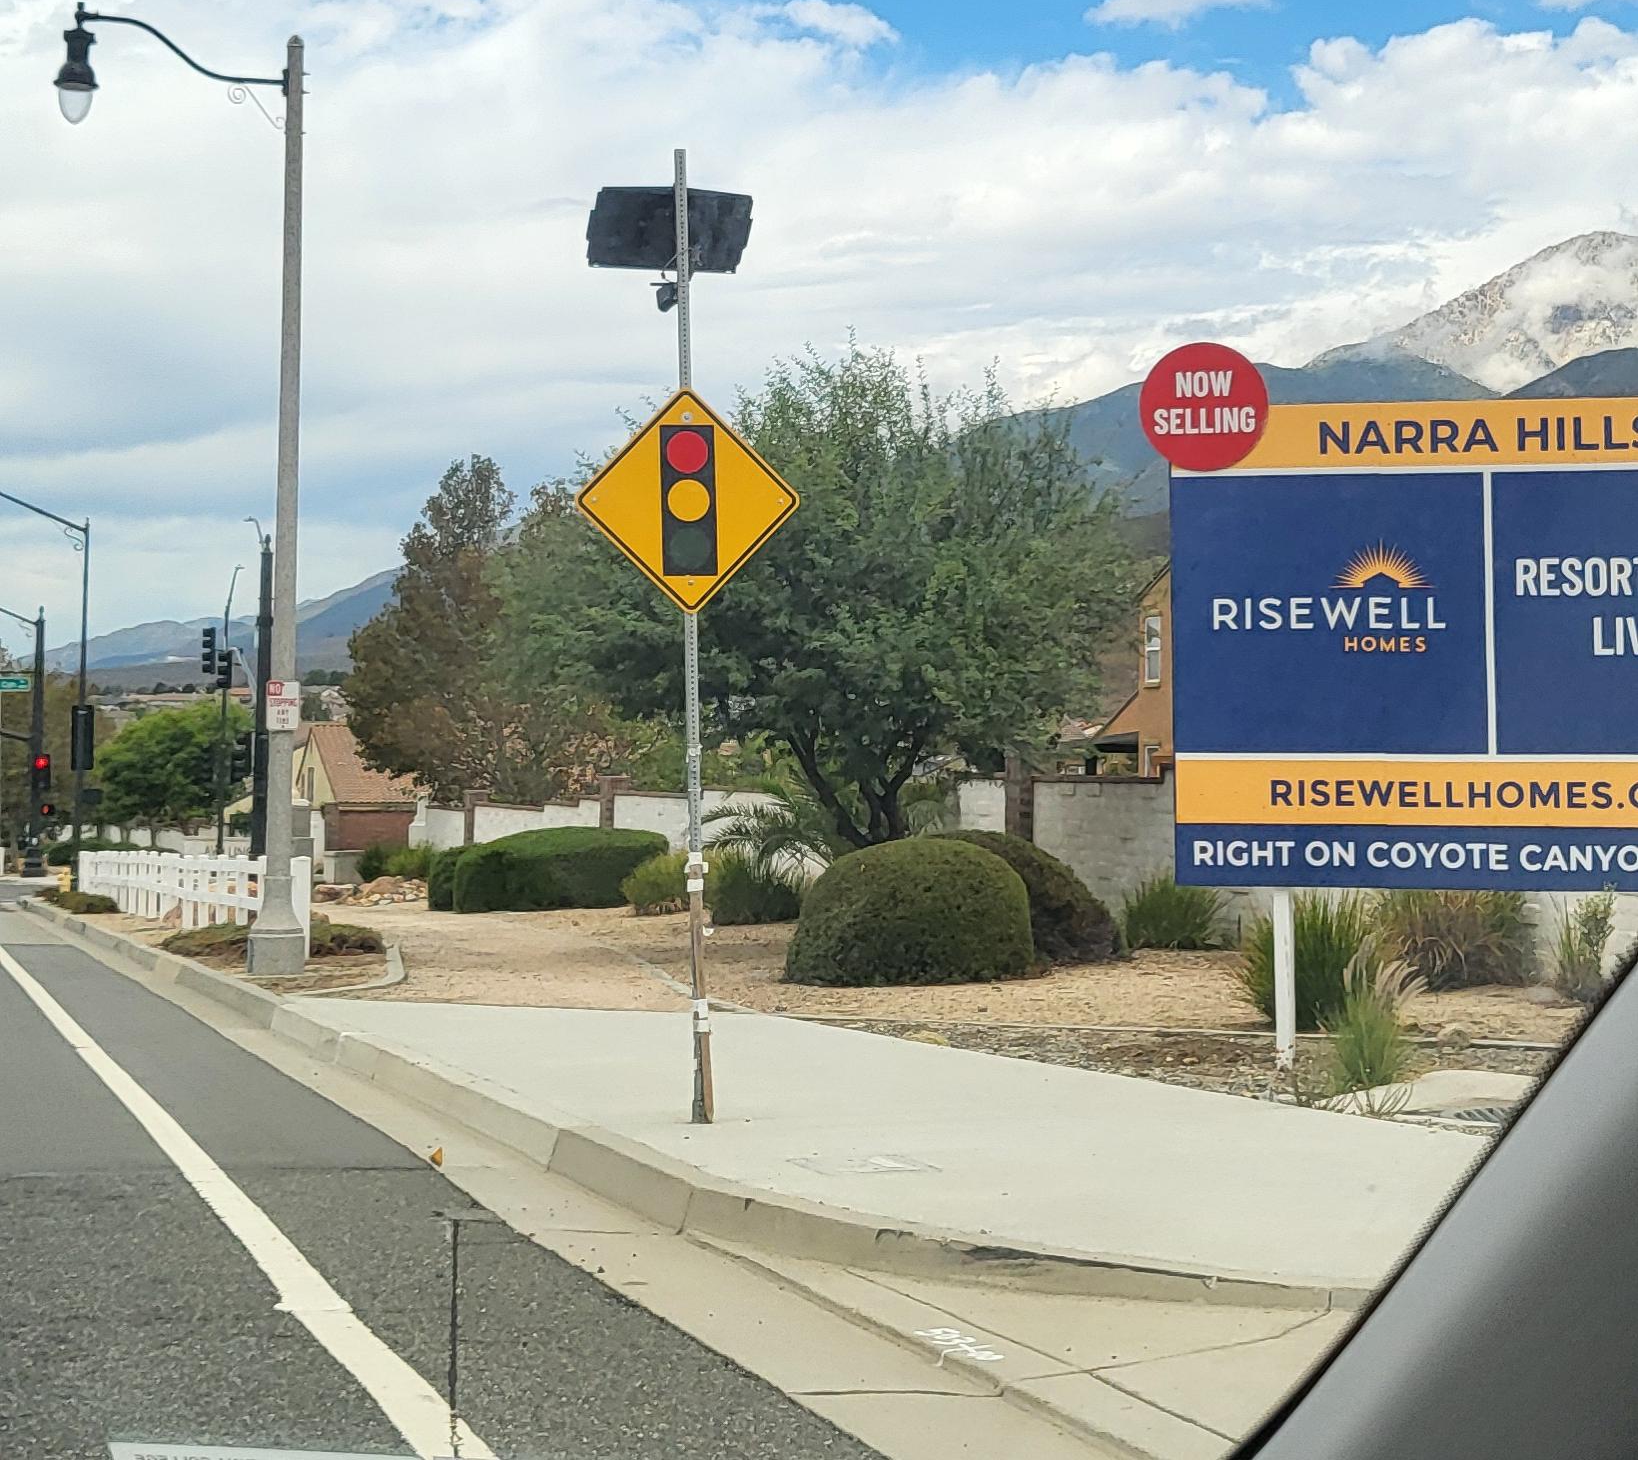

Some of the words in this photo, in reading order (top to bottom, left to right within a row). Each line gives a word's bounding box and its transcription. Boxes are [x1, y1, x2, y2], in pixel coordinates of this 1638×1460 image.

[1175, 370, 1233, 398] NOW
[1153, 407, 1256, 435] SELLING
[1318, 418, 1499, 455] NARRA
[1515, 557, 1638, 597] RESOR
[1212, 596, 1447, 630] RISEWELL
[1343, 636, 1427, 653] HOMES
[269, 683, 281, 695] NO
[1193, 840, 1295, 867] RIGHT
[1304, 841, 1355, 867] ON
[1366, 841, 1509, 871] COYOTE
[1519, 844, 1638, 872] CANYO
